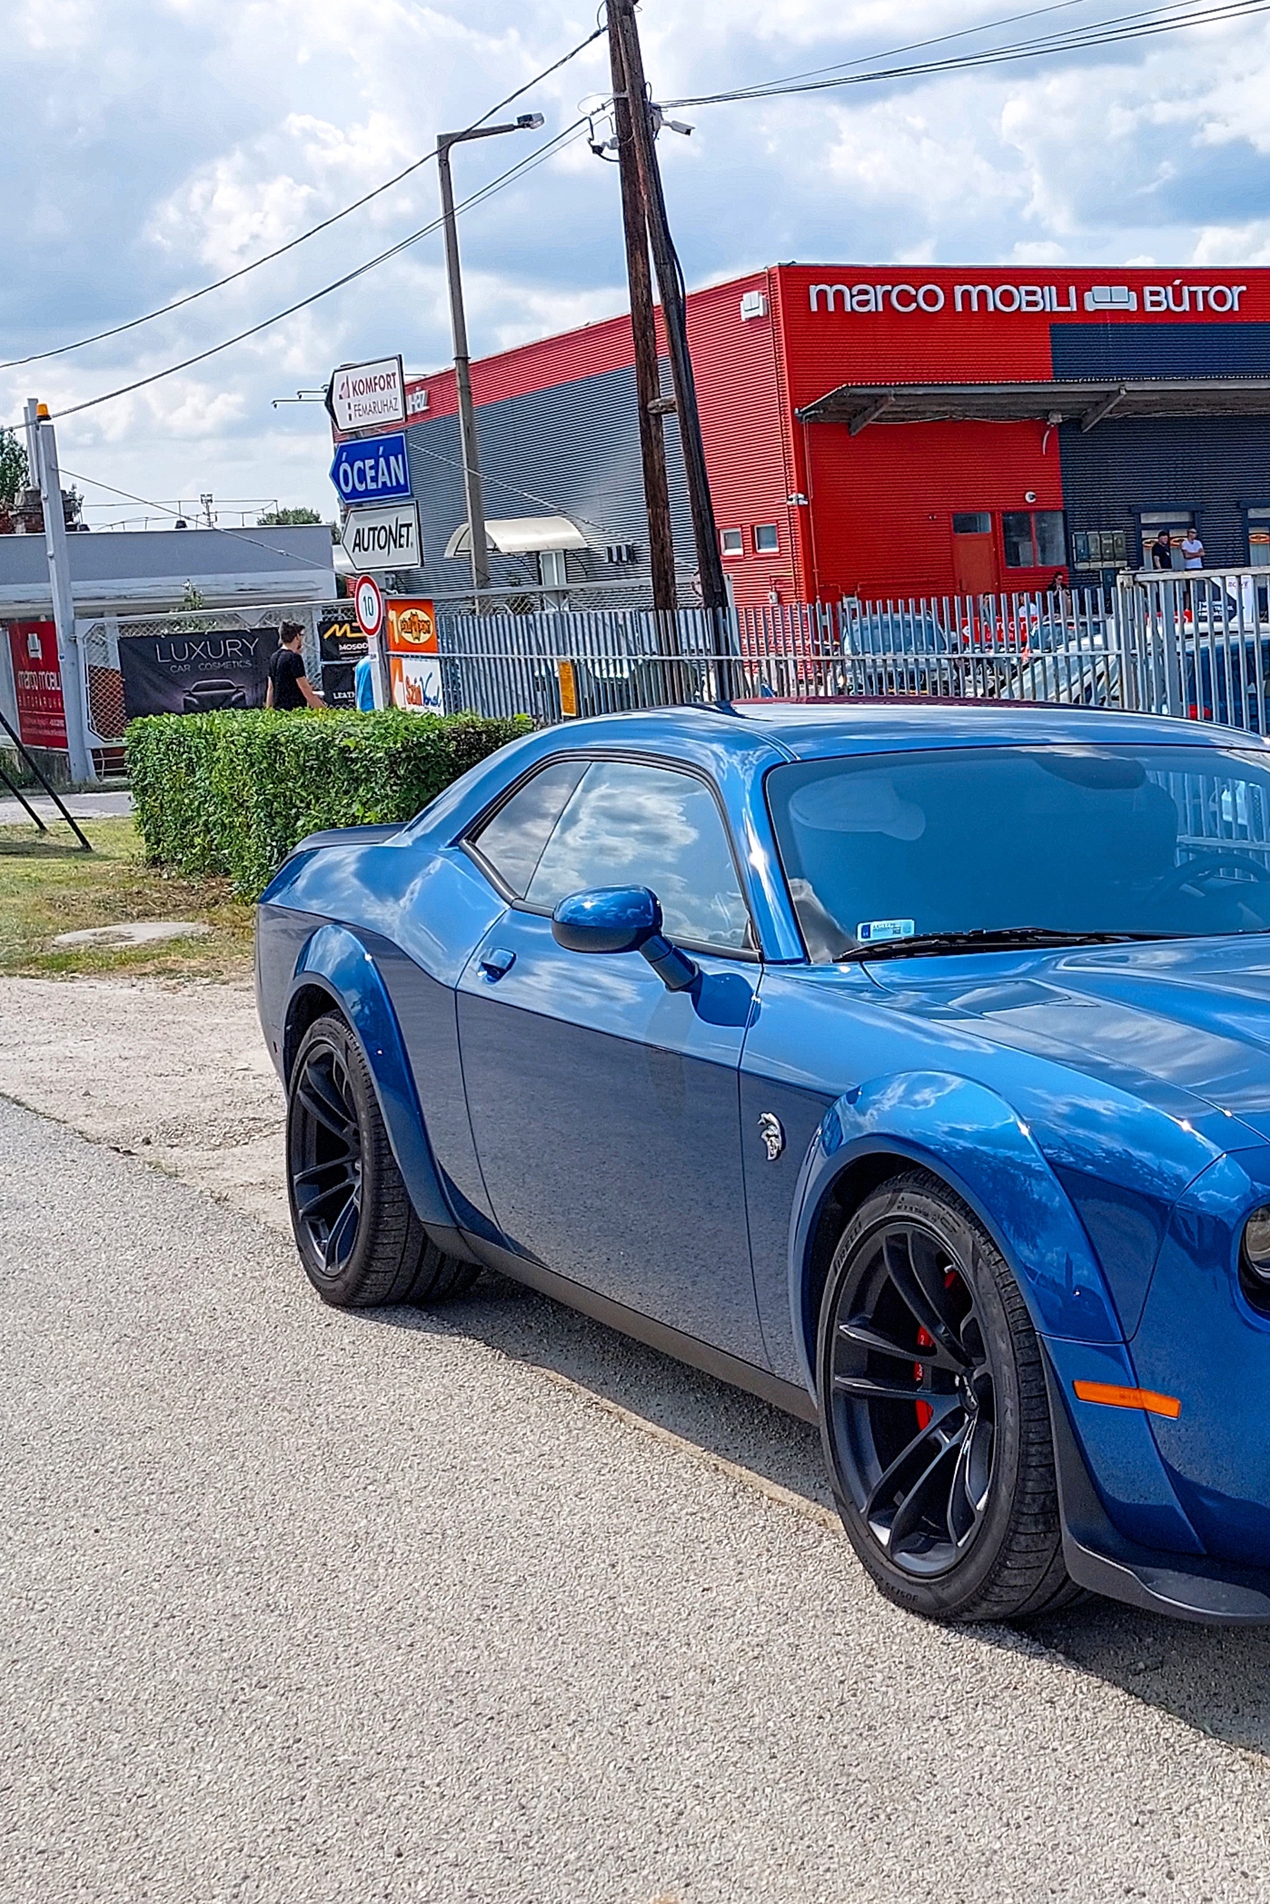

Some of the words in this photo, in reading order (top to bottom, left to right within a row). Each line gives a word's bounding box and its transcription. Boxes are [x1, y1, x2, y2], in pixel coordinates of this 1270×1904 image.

[809, 284, 945, 312] marco
[352, 372, 397, 397] KOMFORT
[340, 446, 404, 493] ÓCEÁN
[363, 595, 374, 616] 10
[156, 638, 259, 663] LUXURY
[170, 664, 191, 674] CAR
[198, 659, 252, 672] COSMETICS
